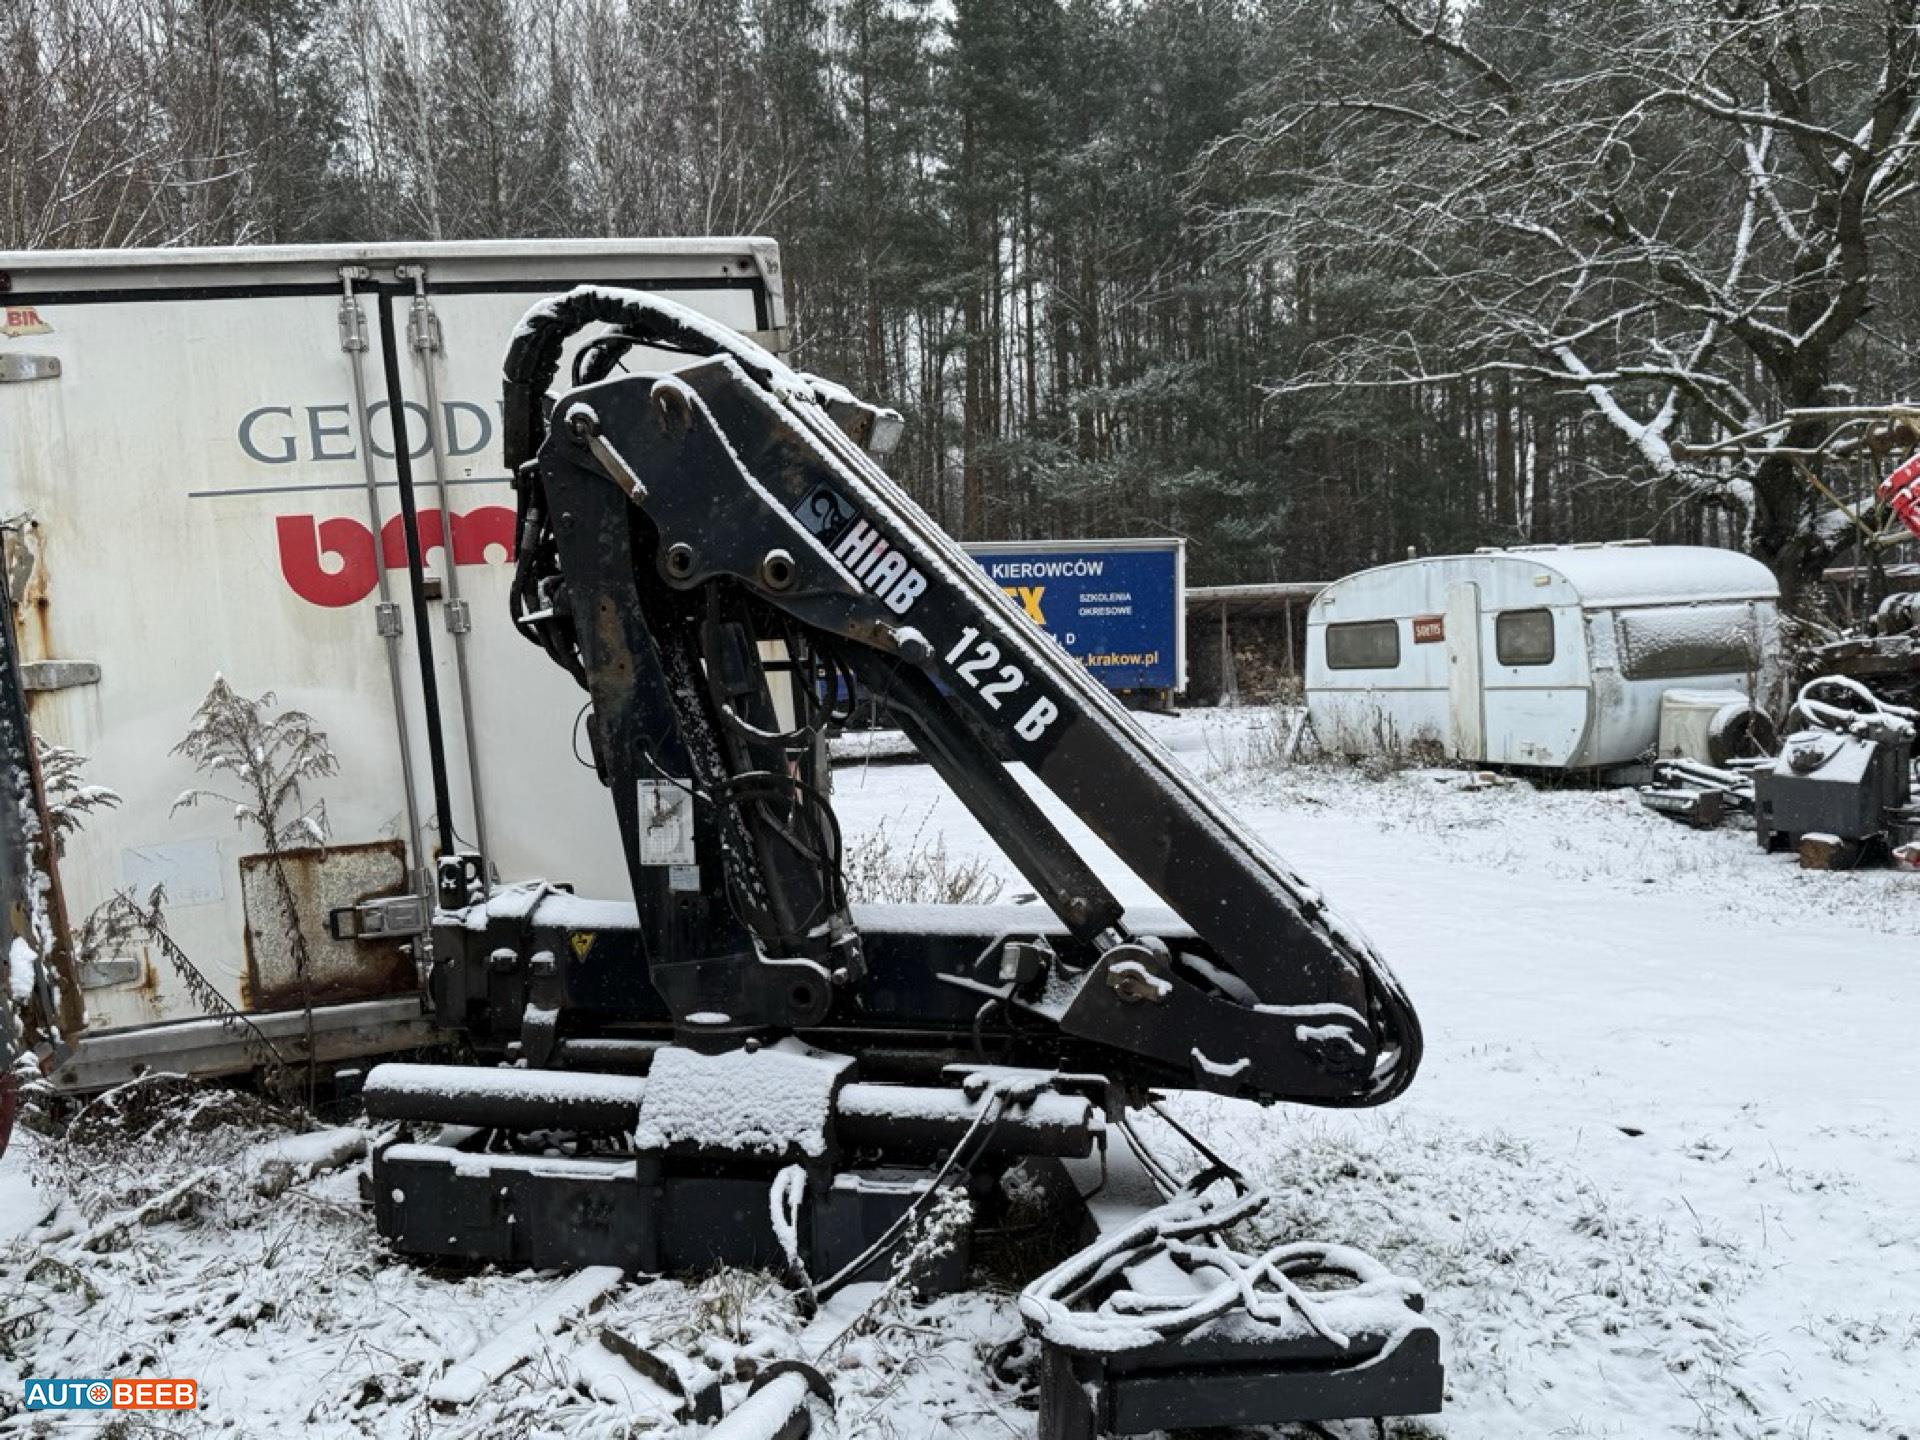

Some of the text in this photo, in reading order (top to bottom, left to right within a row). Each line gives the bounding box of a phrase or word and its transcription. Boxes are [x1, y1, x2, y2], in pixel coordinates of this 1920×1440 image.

[237, 400, 505, 464] GEOD
[993, 559, 1104, 578] KIEROWCÓW
[1080, 592, 1132, 602] SZKOLENIA
[1078, 606, 1132, 616] OKRESOWE
[833, 518, 1059, 741] HIAB 122 B
[1066, 633, 1076, 644] D
